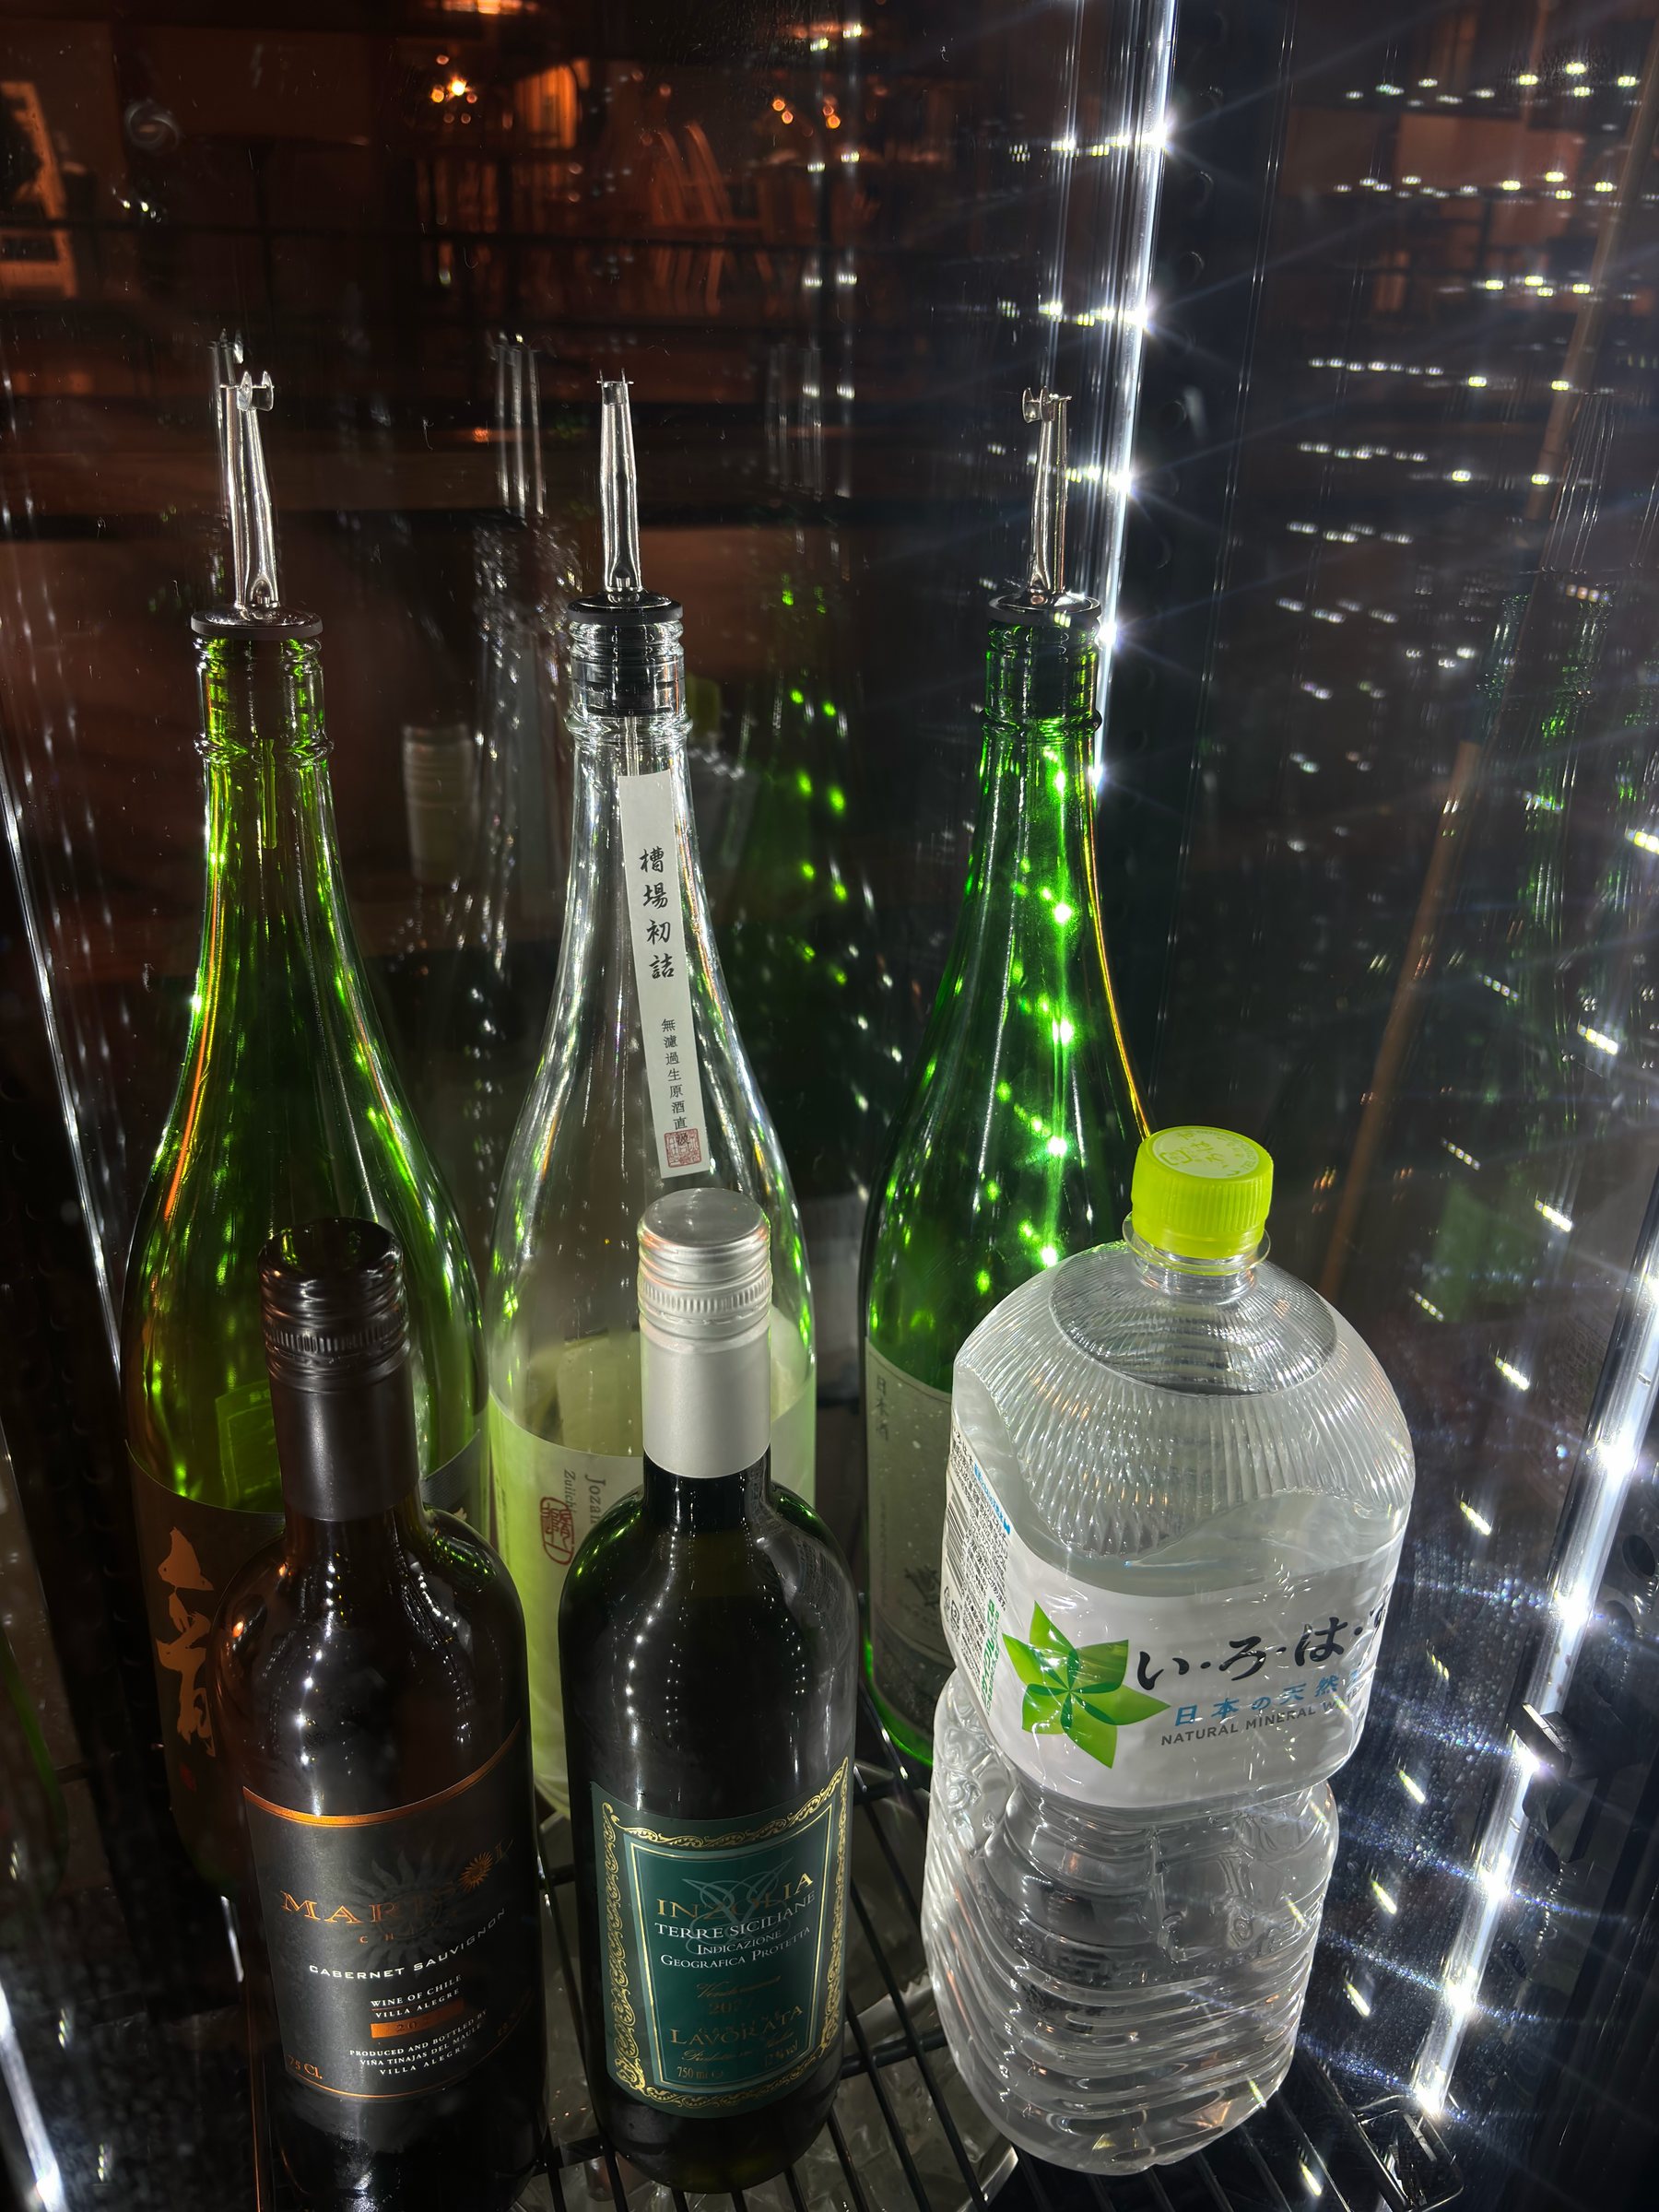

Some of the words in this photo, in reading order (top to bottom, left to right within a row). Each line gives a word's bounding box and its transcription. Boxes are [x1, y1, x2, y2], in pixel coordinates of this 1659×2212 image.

[640, 848, 676, 980] 槽場初詰
[661, 1018, 689, 1147] 無濾過生原酒直汲
[1161, 1724, 1239, 1746] NATURAL
[1245, 1707, 1316, 1730] MINERAL
[654, 1922, 724, 1939] TERRE
[730, 1890, 816, 1937] SICILIANE
[309, 1964, 405, 1980] CABERNET
[413, 1907, 506, 1971] SAUVIGNON
[371, 1996, 404, 2007] WINE
[407, 1991, 423, 2002] OF
[426, 1973, 464, 1997] CHILE
[374, 2007, 410, 2018] VILLA
[416, 1987, 460, 2012] ALEGRE
[349, 2048, 404, 2057] PRODUCED
[407, 2041, 429, 2053] AND
[432, 2019, 475, 2045] BOTTLED
[359, 2056, 384, 2065] VIÑA
[386, 2052, 428, 2065] TINAJAS
[430, 2042, 450, 2054] DEL
[379, 2065, 417, 2076] VILLA
[423, 2043, 468, 2068] ALEGRE
[677, 2065, 694, 2079] 750
